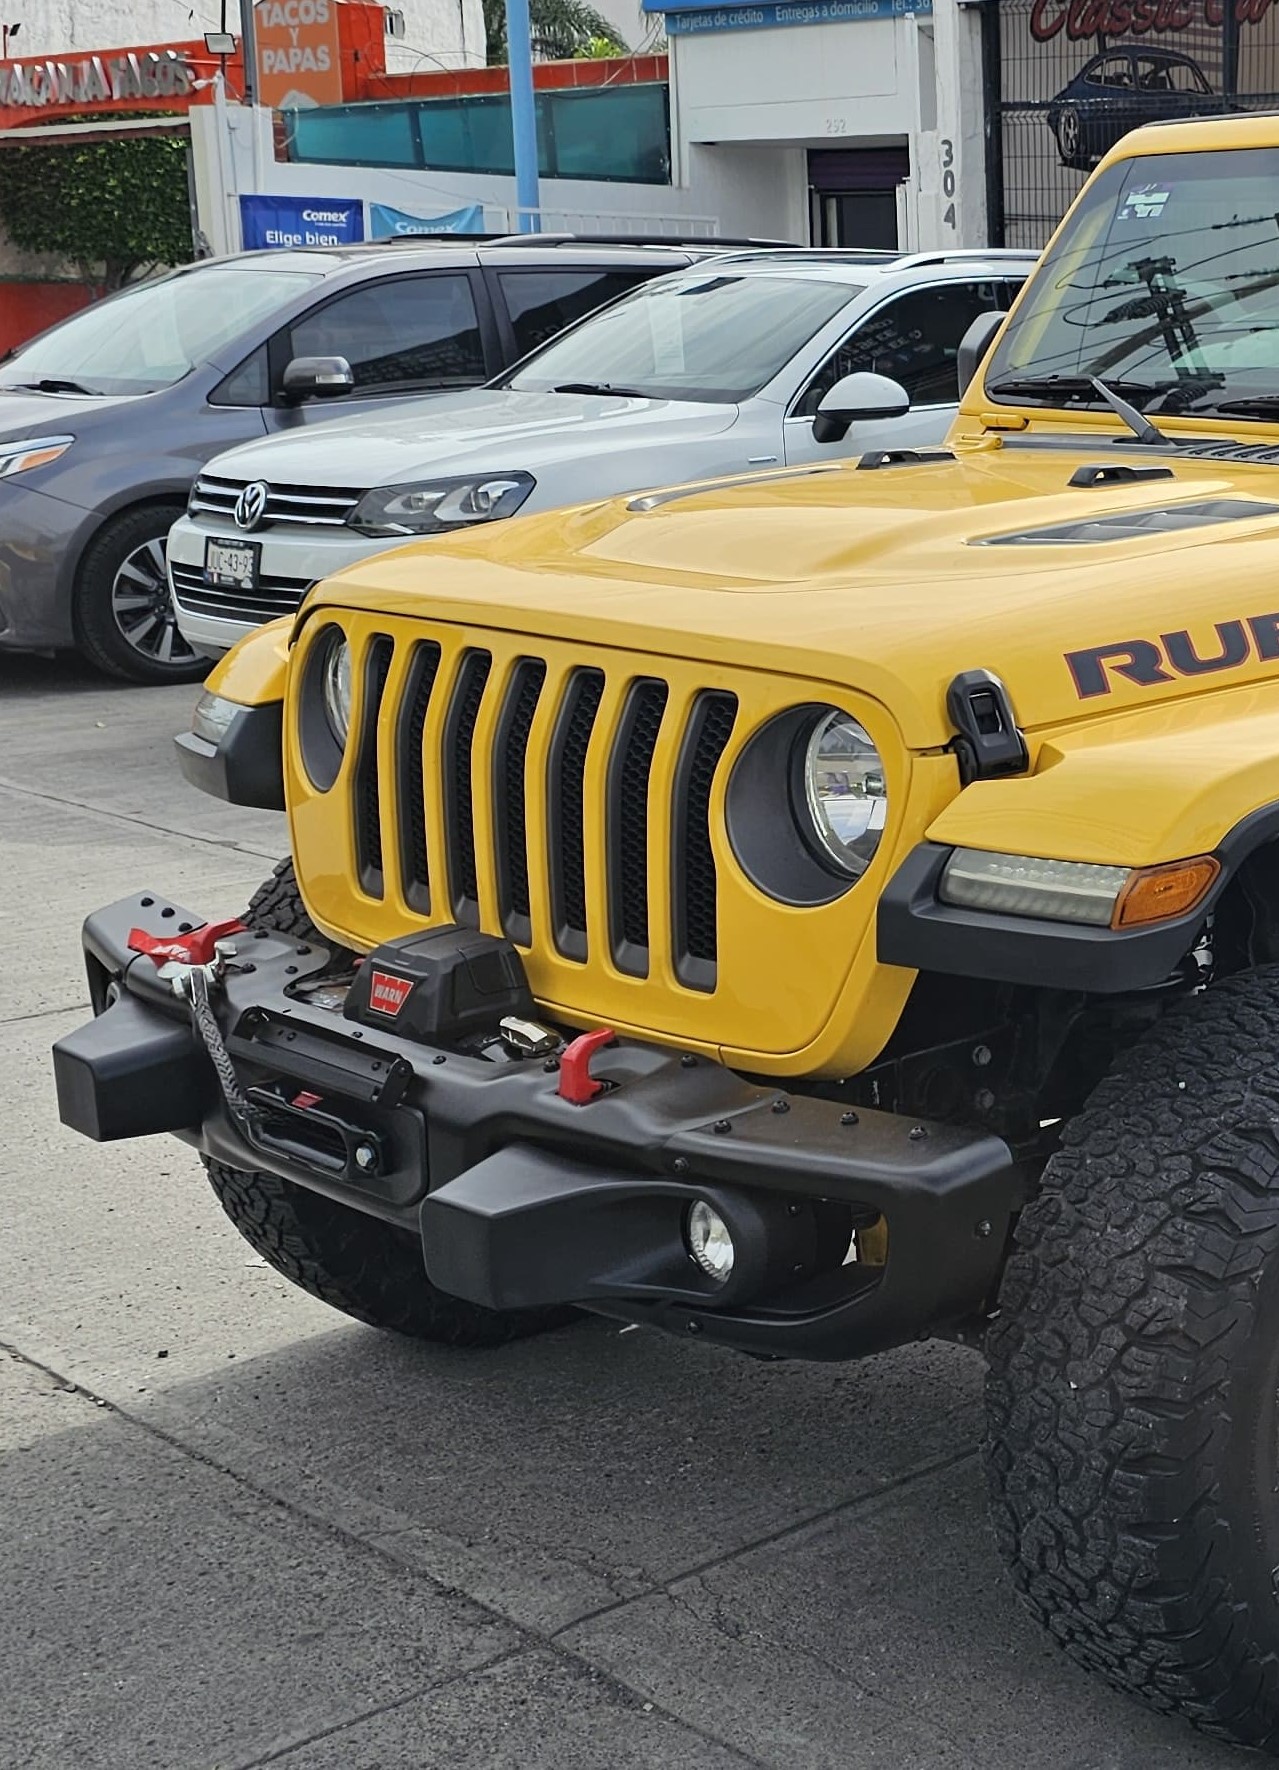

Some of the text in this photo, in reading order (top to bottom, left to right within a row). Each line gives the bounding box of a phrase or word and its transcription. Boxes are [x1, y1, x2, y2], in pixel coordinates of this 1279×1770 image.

[259, 0, 330, 28] TACOS
[675, 13, 713, 32] Tarjetas
[714, 10, 727, 26] de
[729, 8, 764, 25] crédito
[775, 5, 820, 22] Entregas
[821, 5, 828, 17] a
[829, 1, 879, 17] domicilio
[289, 27, 300, 47] Y
[262, 45, 331, 75] PAPAS
[941, 139, 955, 230] 304
[302, 209, 350, 223] Comex
[266, 230, 302, 247] Elige
[374, 984, 404, 1005] WARN
